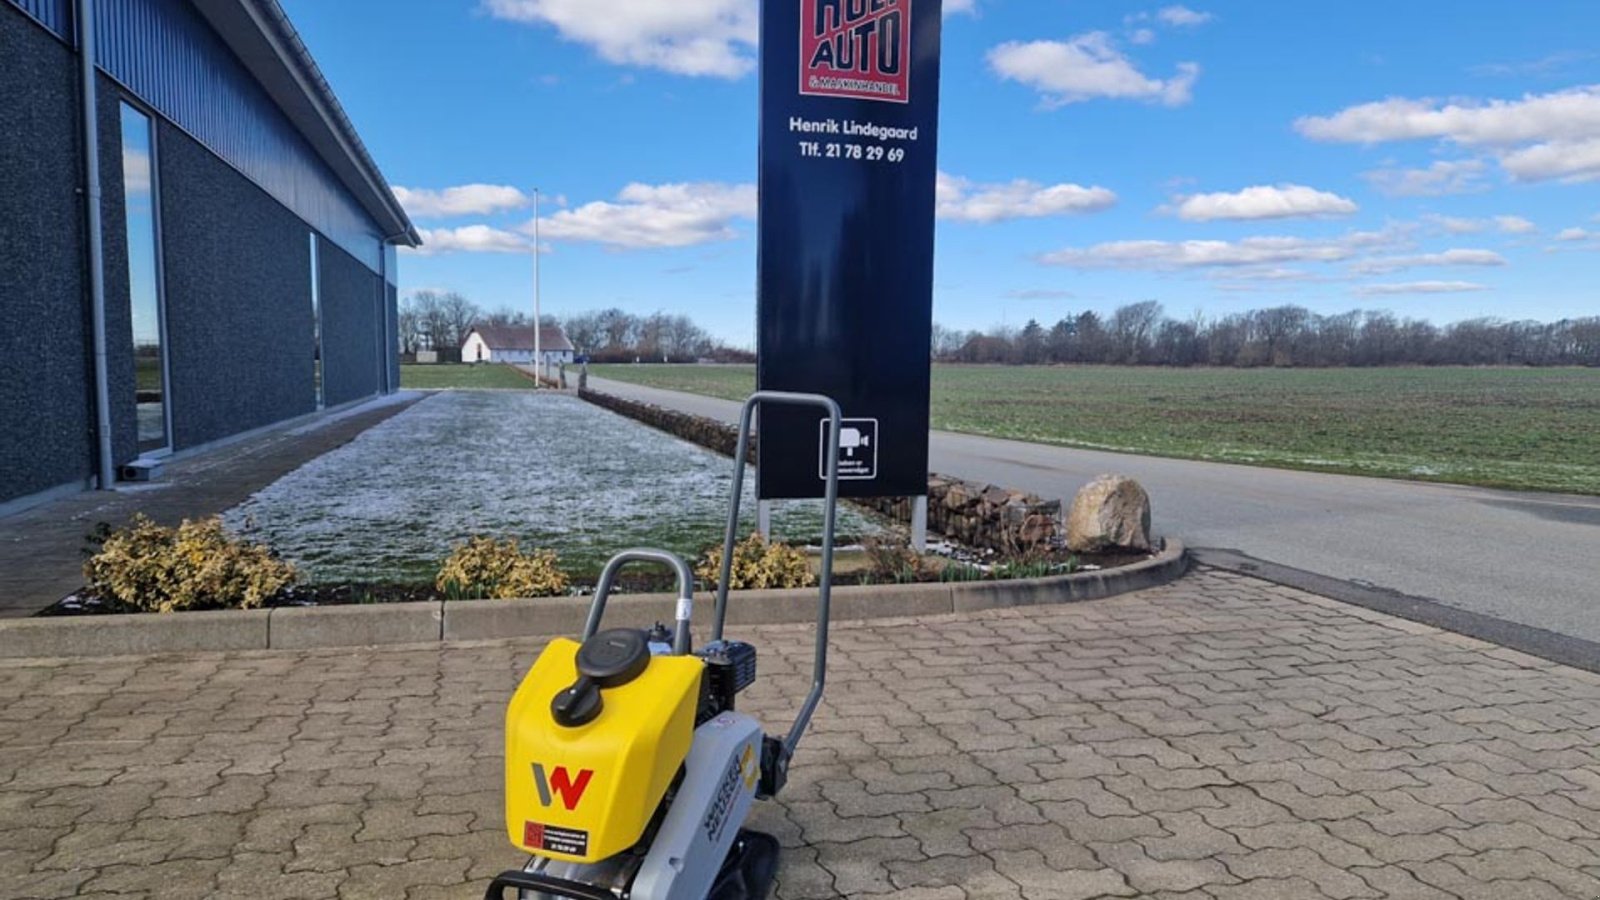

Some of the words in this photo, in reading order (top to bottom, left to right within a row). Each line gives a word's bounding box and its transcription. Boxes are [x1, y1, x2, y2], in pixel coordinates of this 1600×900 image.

[809, 10, 901, 76] AUTO
[789, 117, 839, 133] Henrik
[843, 120, 918, 140] Lindegaard
[799, 142, 821, 157] Tlf.
[825, 143, 840, 157] 21
[844, 144, 862, 159] 78
[866, 146, 883, 160] 29
[887, 148, 904, 162] 69
